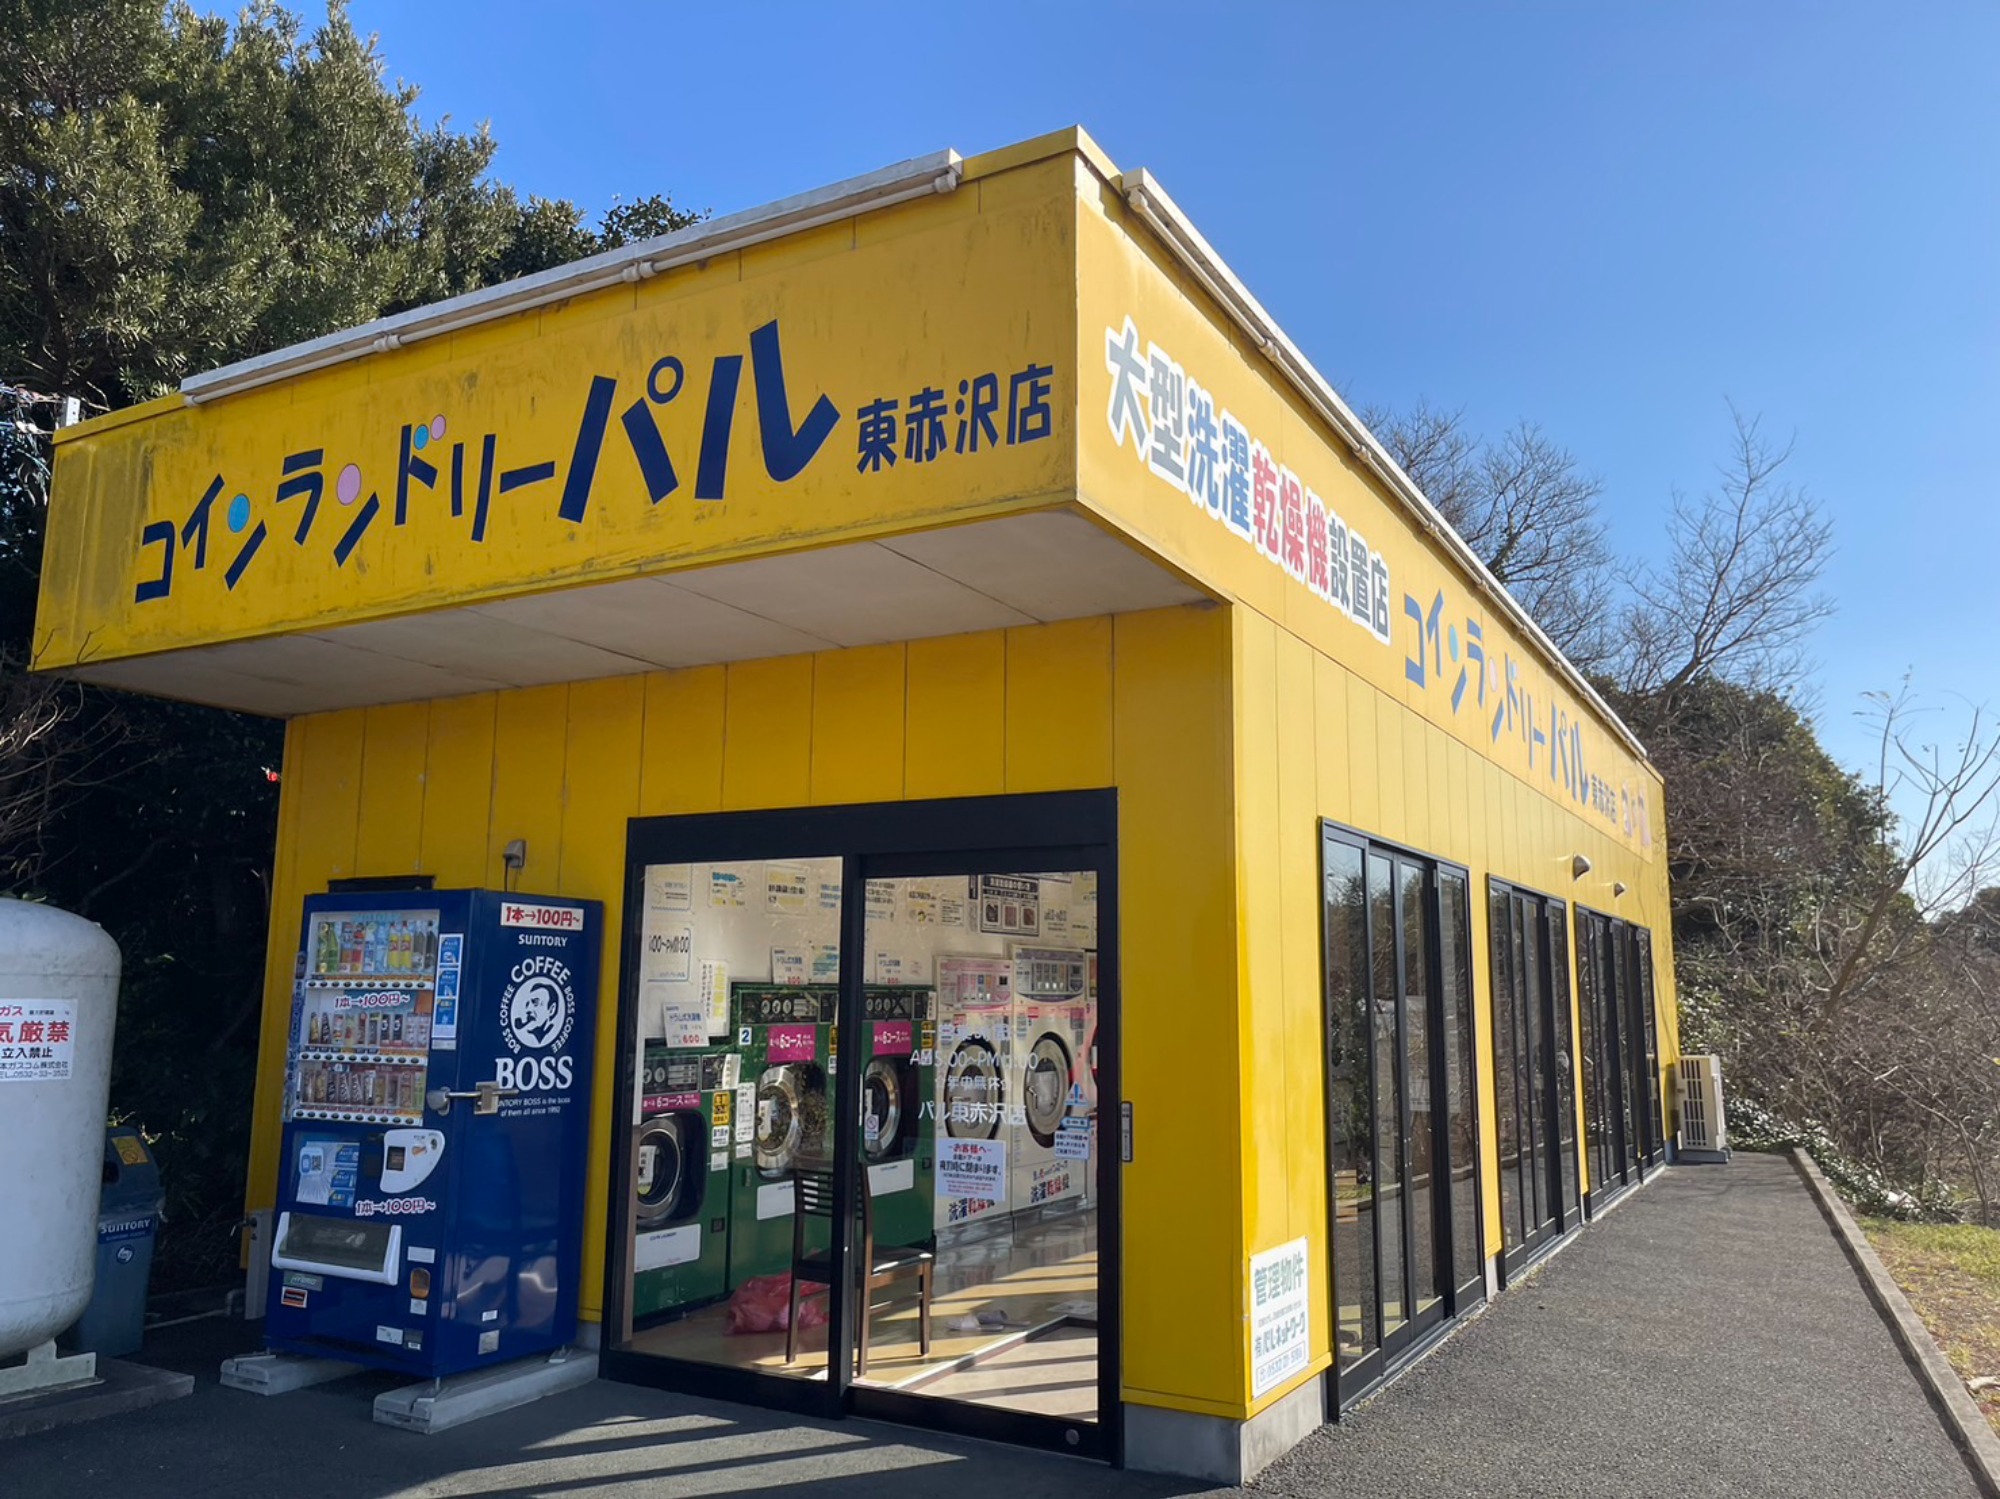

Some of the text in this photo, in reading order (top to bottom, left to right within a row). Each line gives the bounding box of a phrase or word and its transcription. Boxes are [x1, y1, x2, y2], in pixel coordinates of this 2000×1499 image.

[857, 363, 1053, 474] 東赤沢店
[1106, 316, 1391, 644] 大型洗濯乾燥機設置店
[511, 956, 571, 986] COFFEE
[499, 983, 521, 1055] BOSS COFFEE
[551, 985, 576, 1054] BOSS COFFEE
[742, 1029, 750, 1043] 2
[1, 1046, 53, 1059] 立入禁止
[495, 1055, 574, 1092] BOSS
[1254, 1251, 1304, 1307] 管理物件
